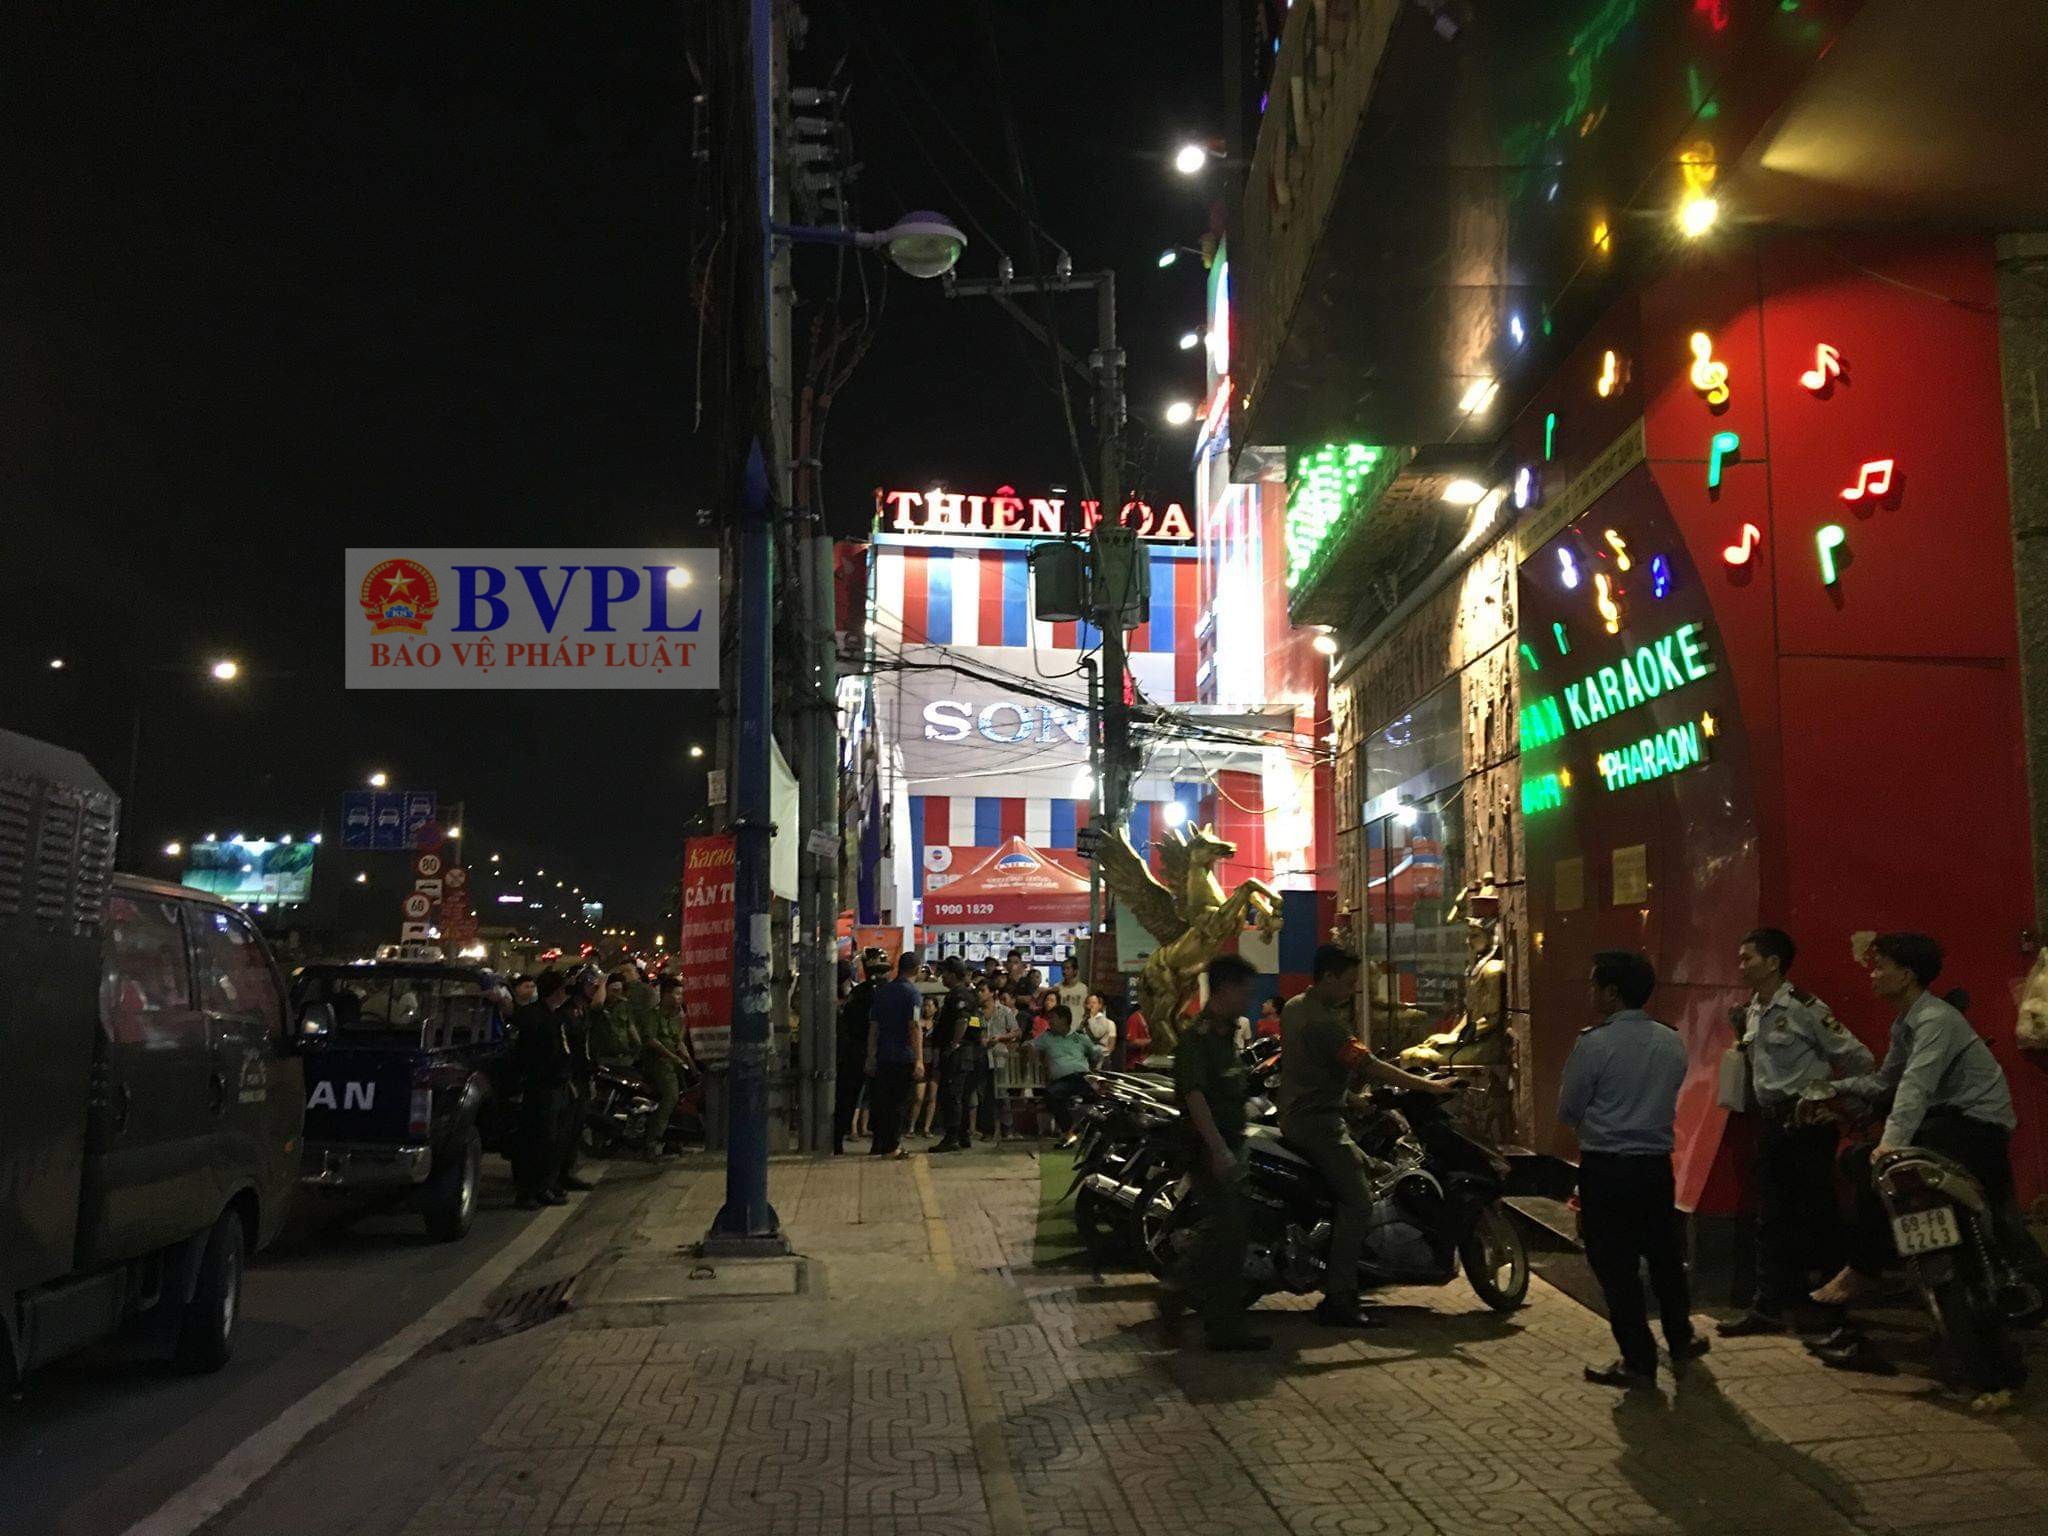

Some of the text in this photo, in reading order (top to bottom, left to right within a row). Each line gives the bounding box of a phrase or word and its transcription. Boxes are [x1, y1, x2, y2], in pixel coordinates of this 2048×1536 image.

[886, 485, 1065, 533] THIÊN
[1564, 623, 1709, 730] KARAOKE
[1602, 720, 1701, 792] PHARAON
[422, 858, 438, 871] 80
[411, 900, 425, 912] 60
[934, 904, 994, 915] 1900 1829
[306, 1080, 377, 1110] AN
